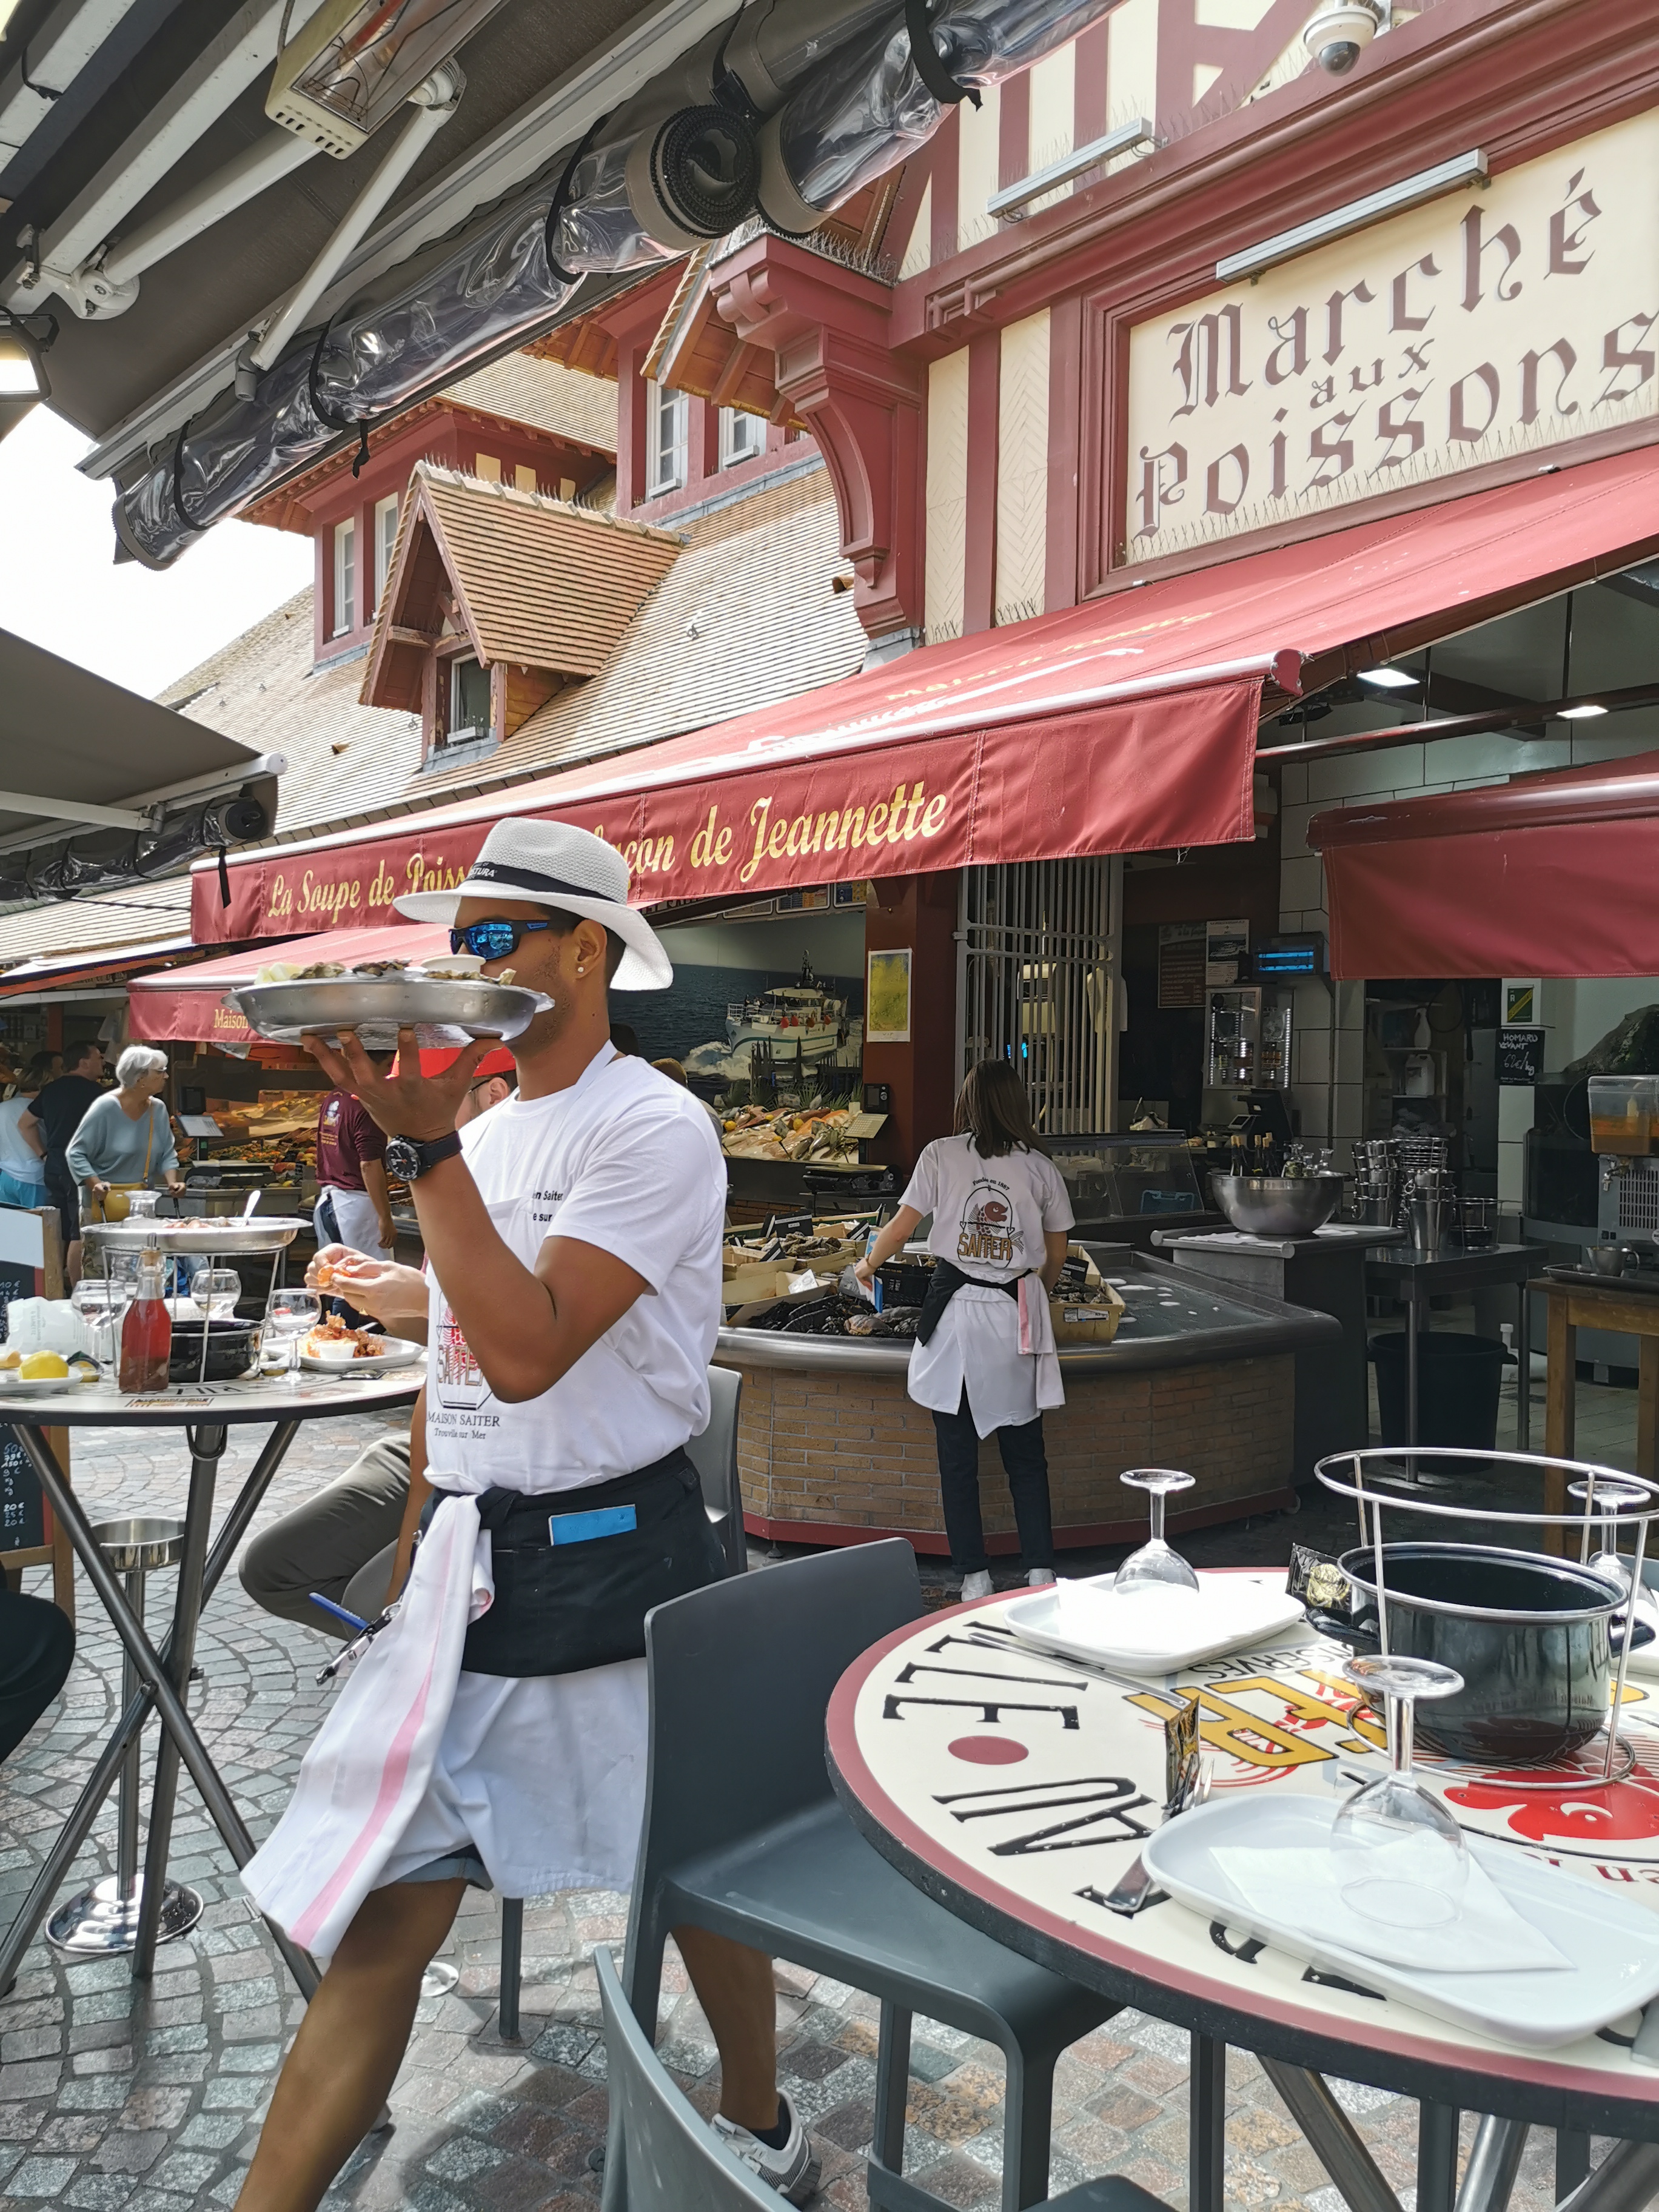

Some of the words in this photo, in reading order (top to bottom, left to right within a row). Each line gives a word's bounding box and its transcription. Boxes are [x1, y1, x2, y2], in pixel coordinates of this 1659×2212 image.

[1166, 167, 1603, 424] Marché
[1309, 338, 1435, 409] aux
[1133, 310, 1659, 541] Poissons
[690, 804, 733, 868] de
[740, 780, 947, 883] Jeannette
[267, 874, 292, 917] La
[297, 870, 361, 923] Soupe
[368, 859, 395, 907] de
[403, 853, 472, 893] Poiss
[213, 1009, 249, 1029] Maison
[538, 1213, 553, 1222] sur
[957, 1233, 1012, 1261] SAITER
[426, 1410, 458, 1425] MAISON
[459, 1414, 501, 1427] SAITER
[471, 1429, 486, 1439] Mer
